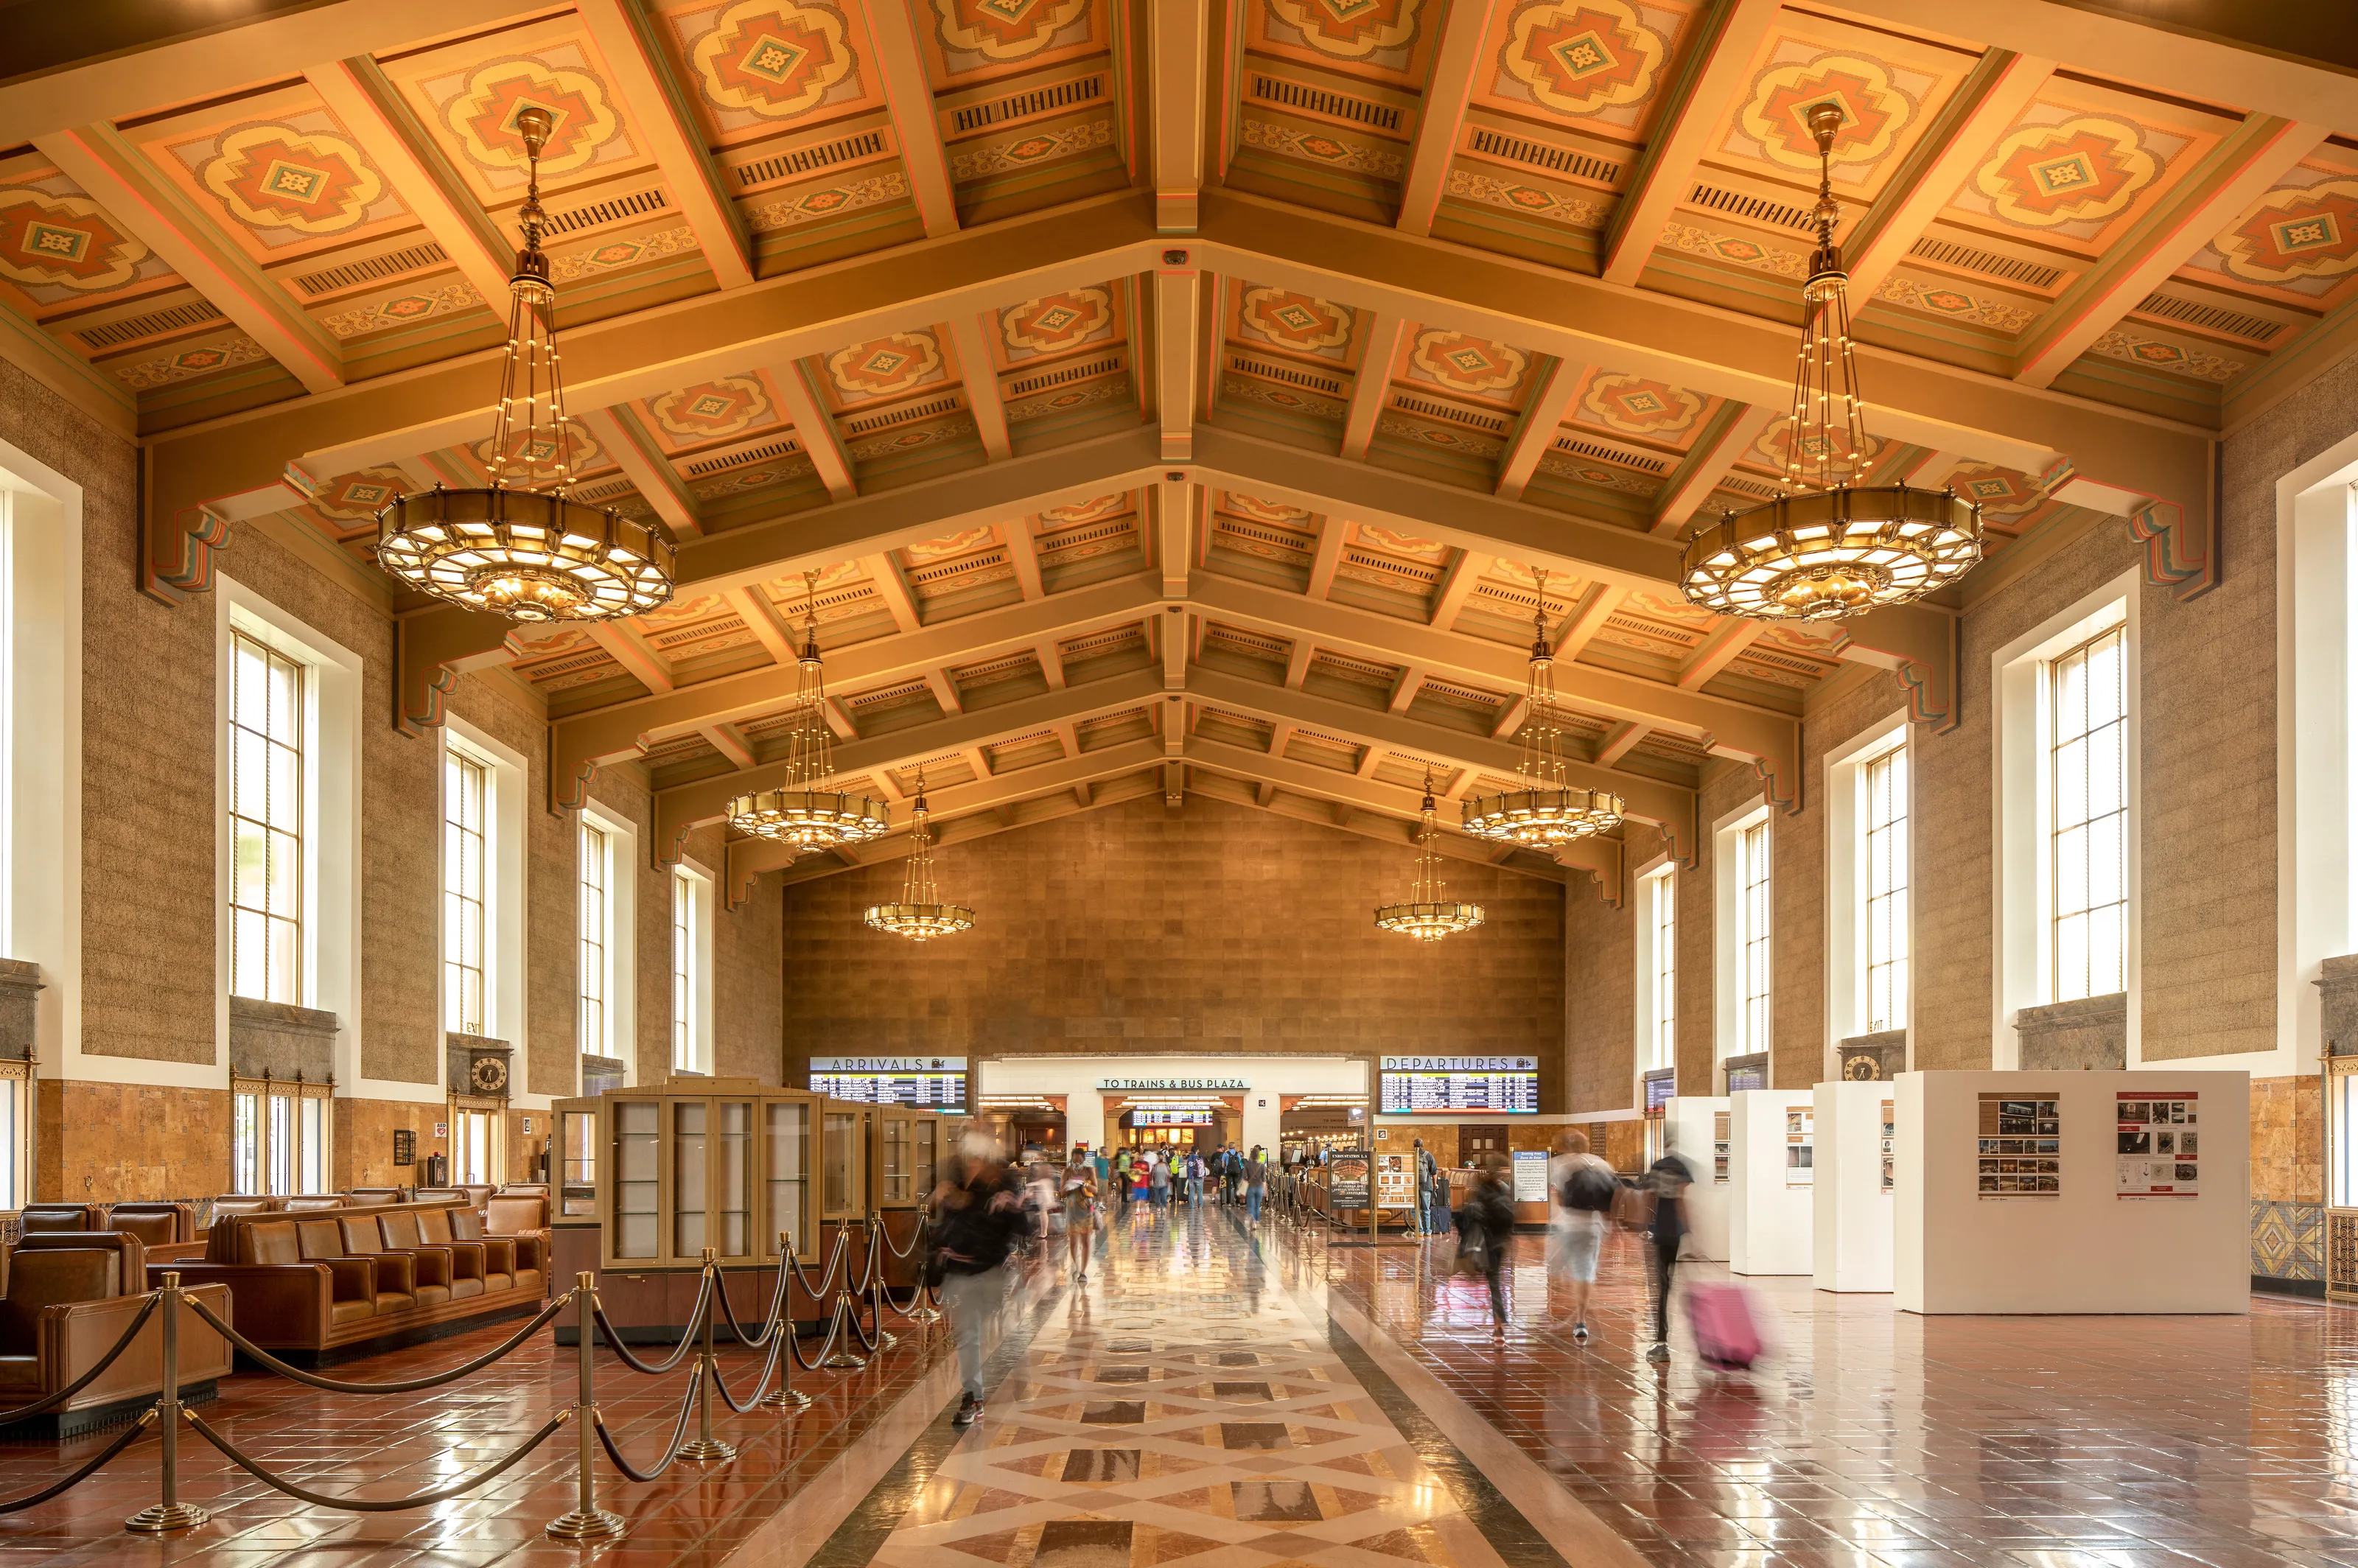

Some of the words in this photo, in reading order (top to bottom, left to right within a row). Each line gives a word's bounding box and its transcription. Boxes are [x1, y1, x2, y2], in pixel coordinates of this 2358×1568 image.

[832, 1059, 923, 1071] ARRIVALS
[1387, 1058, 1508, 1070] DEPARTURES
[1104, 1079, 1119, 1088] TO
[1124, 1079, 1165, 1088] TRAINS
[1169, 1079, 1176, 1088] &
[1181, 1079, 1203, 1088] BUS
[1207, 1079, 1245, 1088] PLAZA
